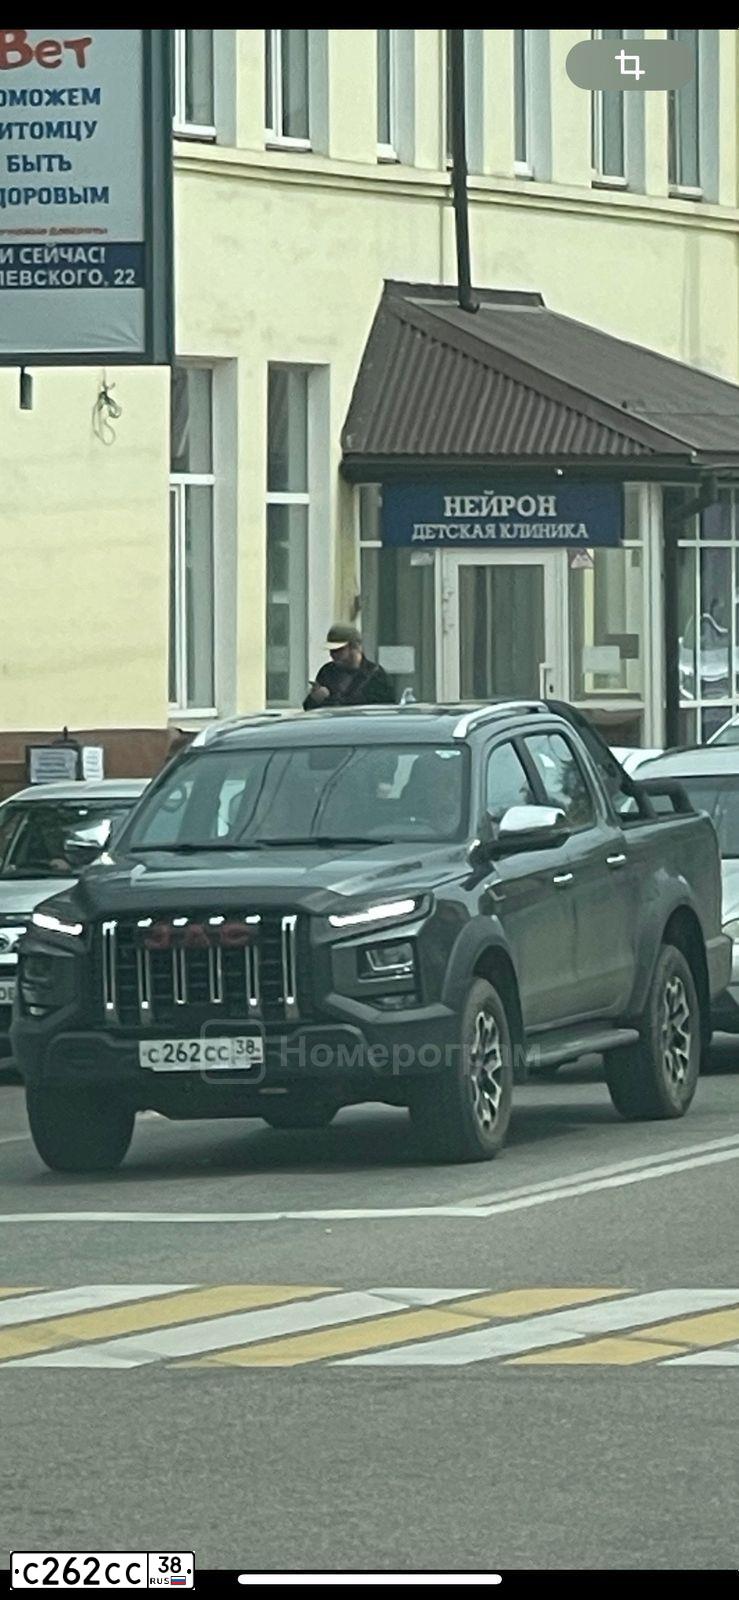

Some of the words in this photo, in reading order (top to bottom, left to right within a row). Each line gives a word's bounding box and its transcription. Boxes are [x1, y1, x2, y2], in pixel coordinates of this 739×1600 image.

[0, 29, 92, 70] Вет
[6, 154, 72, 172] БЫТЬ
[19, 242, 105, 264] СЕЙЧАС!
[114, 269, 135, 285] 22
[443, 490, 557, 517] НЕЙРОН
[411, 523, 497, 541] ДЕТСКАЯ
[499, 523, 589, 540] КЛИНИКА
